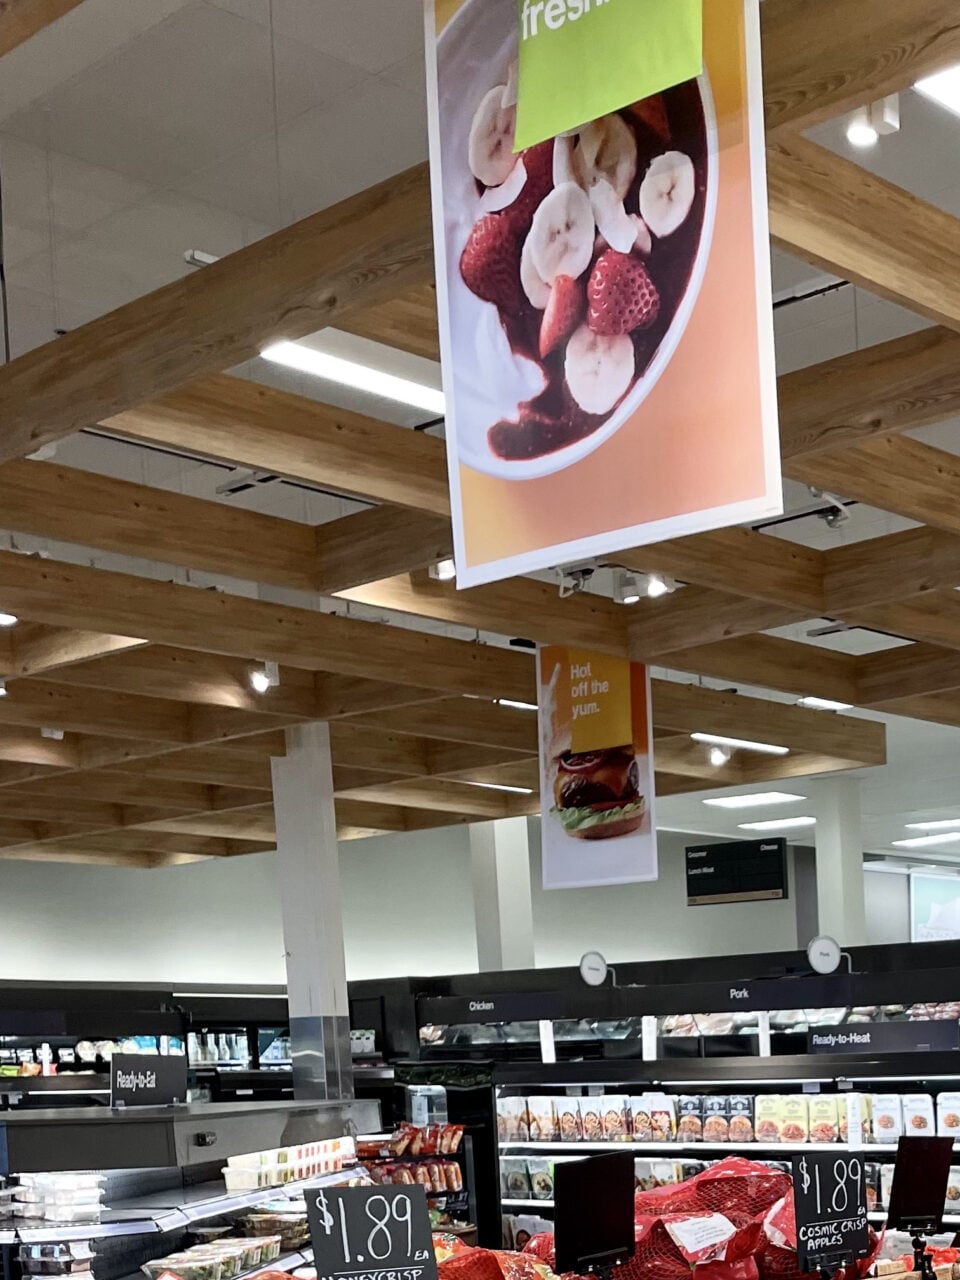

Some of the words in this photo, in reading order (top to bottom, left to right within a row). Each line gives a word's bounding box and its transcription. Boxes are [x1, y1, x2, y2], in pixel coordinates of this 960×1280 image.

[571, 662, 592, 679] Hot
[571, 681, 588, 697] off
[592, 680, 609, 694] the
[572, 703, 600, 720] yum.
[730, 988, 749, 999] Pork
[469, 1001, 494, 1011] Chicken
[812, 1032, 871, 1046] Ready-to-Heat
[116, 1070, 156, 1092] Ready-to-Eat
[799, 1156, 861, 1213] $1.89
[316, 1190, 411, 1262] $1.89
[414, 1250, 429, 1260] EA
[799, 1222, 839, 1240] COSMIC
[841, 1218, 867, 1232] CRISP
[807, 1234, 843, 1250] APPLES
